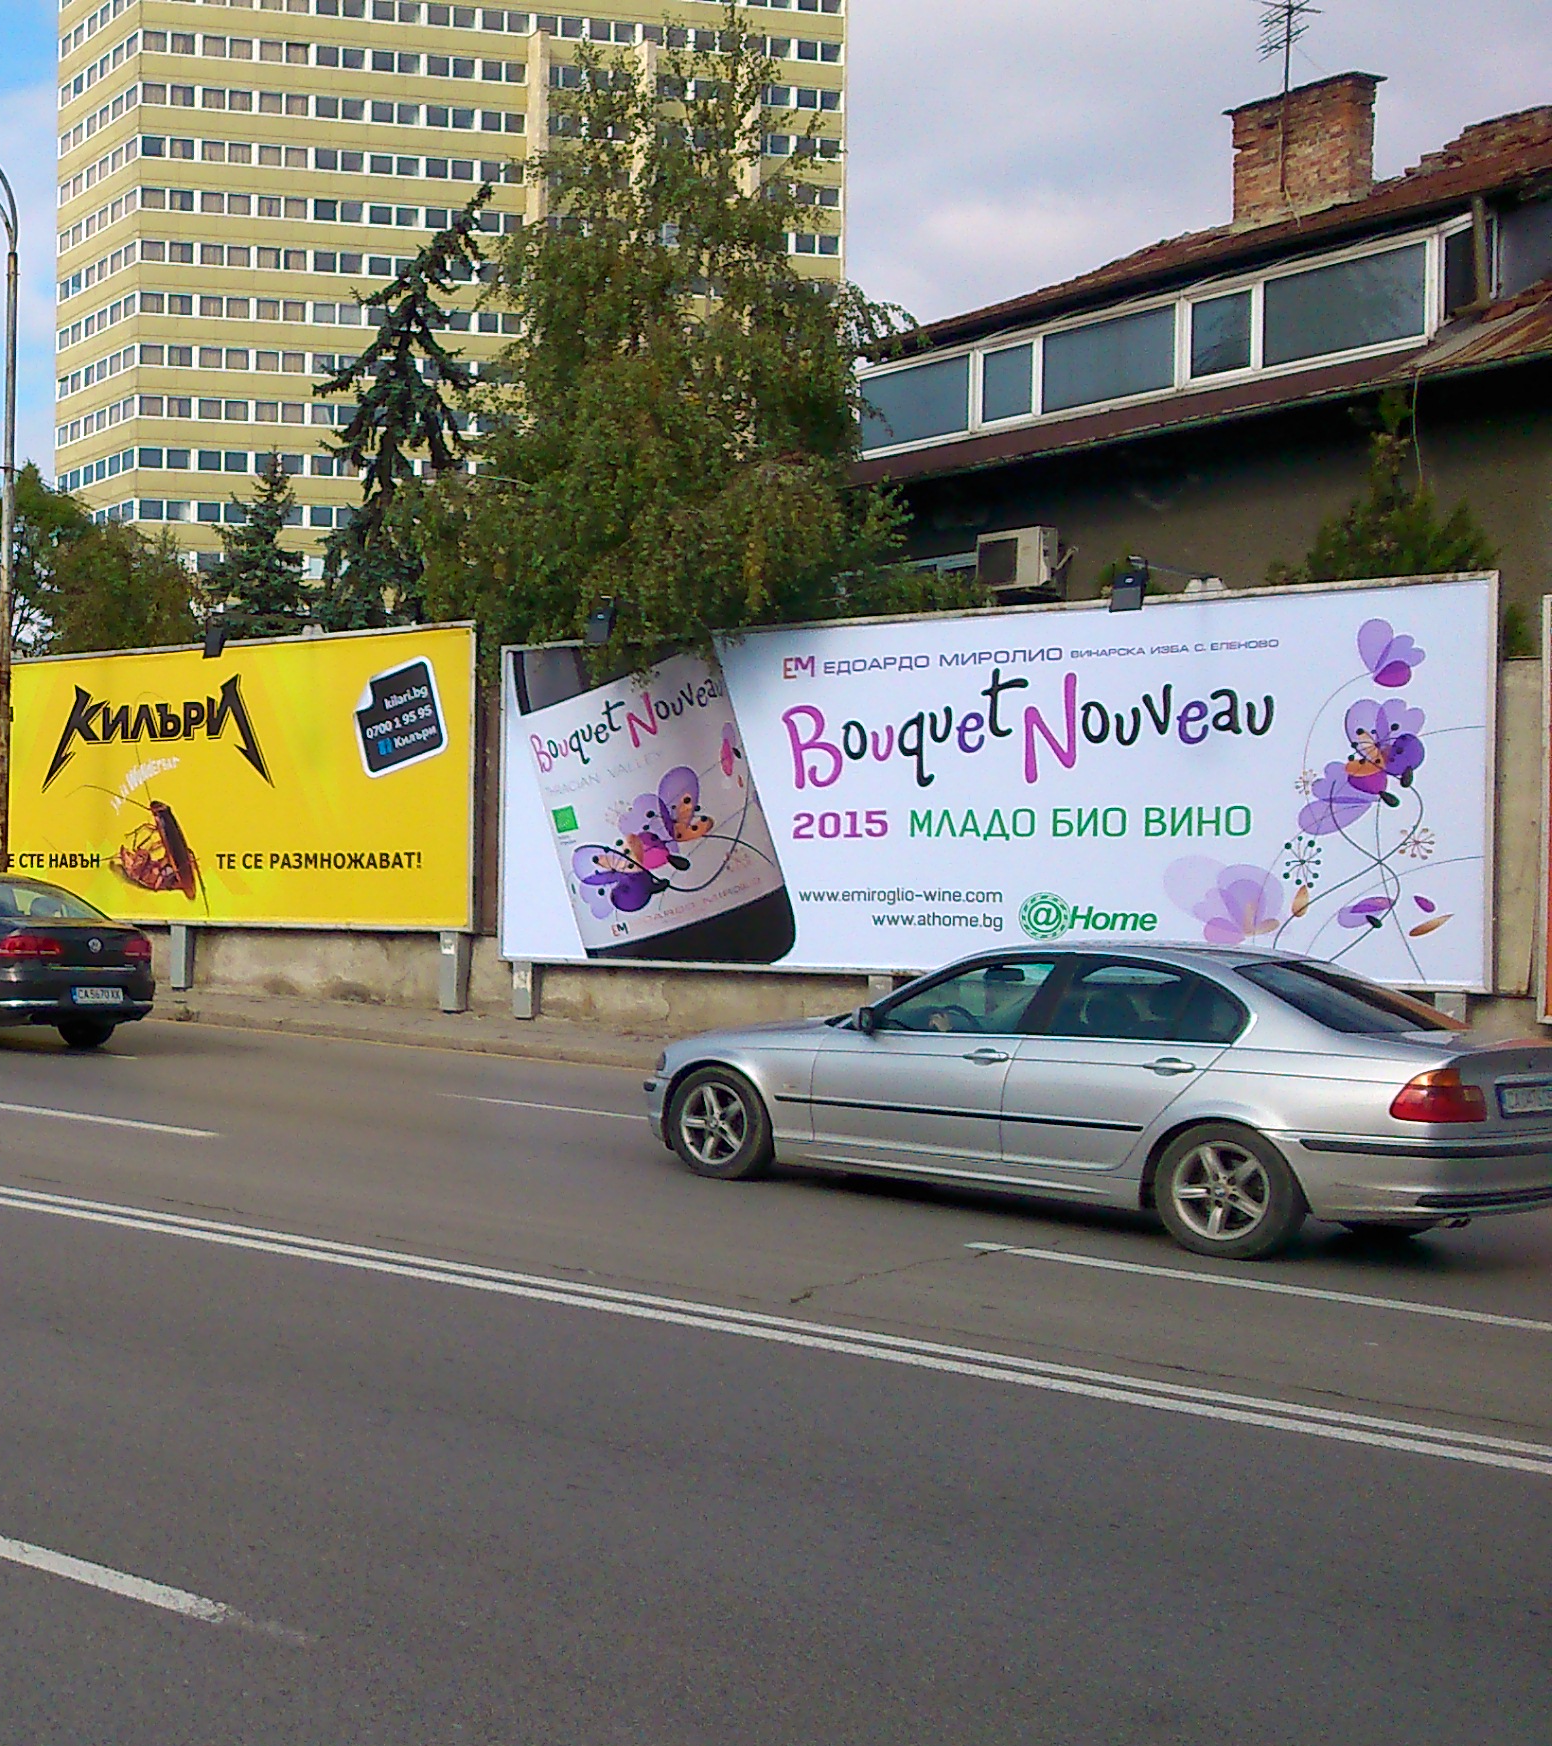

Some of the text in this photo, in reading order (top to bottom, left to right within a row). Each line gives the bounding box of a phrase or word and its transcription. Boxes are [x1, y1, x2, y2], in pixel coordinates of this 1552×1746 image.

[783, 655, 816, 679] EM
[824, 655, 930, 675] ЕДОАРДО
[940, 647, 1062, 667] МИРОЛИО
[1071, 647, 1146, 659] ВИНАРСКА
[1151, 644, 1189, 655] ИЗБА
[1211, 639, 1279, 651] ЕЛЕНОВО
[365, 704, 433, 740] 0700 1 95 95
[394, 726, 437, 747] Килъри
[530, 700, 625, 774] Bouquet
[782, 668, 1274, 789] Bouquet Nouveau
[793, 805, 1252, 842] 2015 МЛАДО БИО ВИНО
[19, 853, 45, 869] СТЕ
[49, 853, 100, 869] НАВЪН
[216, 852, 422, 869] ТЕ СЕ РАЗМНОЖАВАТ!
[798, 888, 1003, 906] www.emiroglio-wine.com
[872, 912, 1003, 932] www.athome.bg
[1028, 896, 1158, 936] @Home
